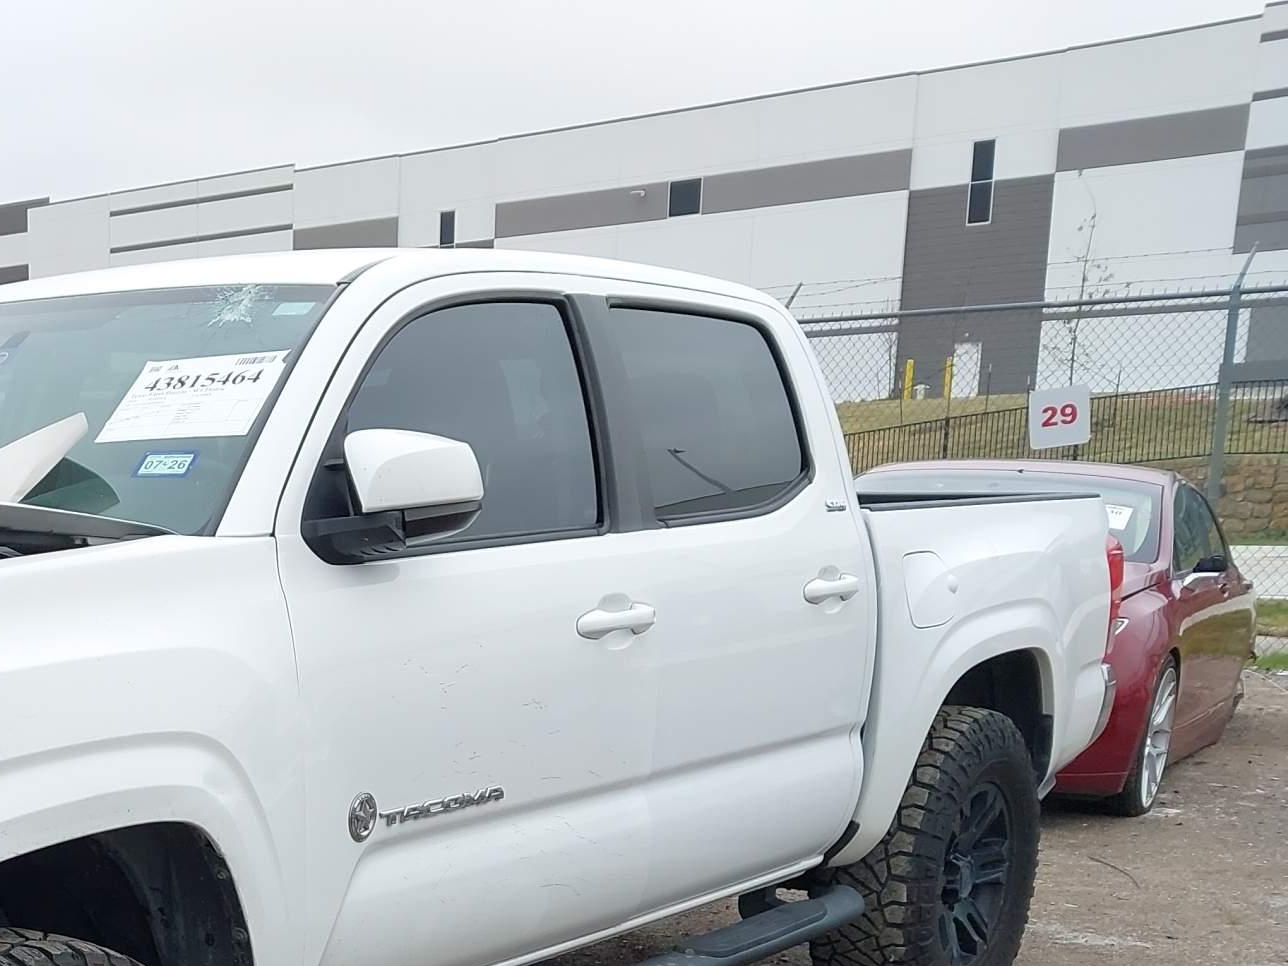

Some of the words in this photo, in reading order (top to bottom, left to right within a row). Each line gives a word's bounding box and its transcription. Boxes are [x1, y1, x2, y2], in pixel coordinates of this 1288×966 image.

[144, 368, 265, 392] 43815464
[1041, 403, 1078, 427] 29
[144, 459, 163, 470] 07
[167, 459, 188, 470] 26
[379, 784, 506, 827] TACOMA
